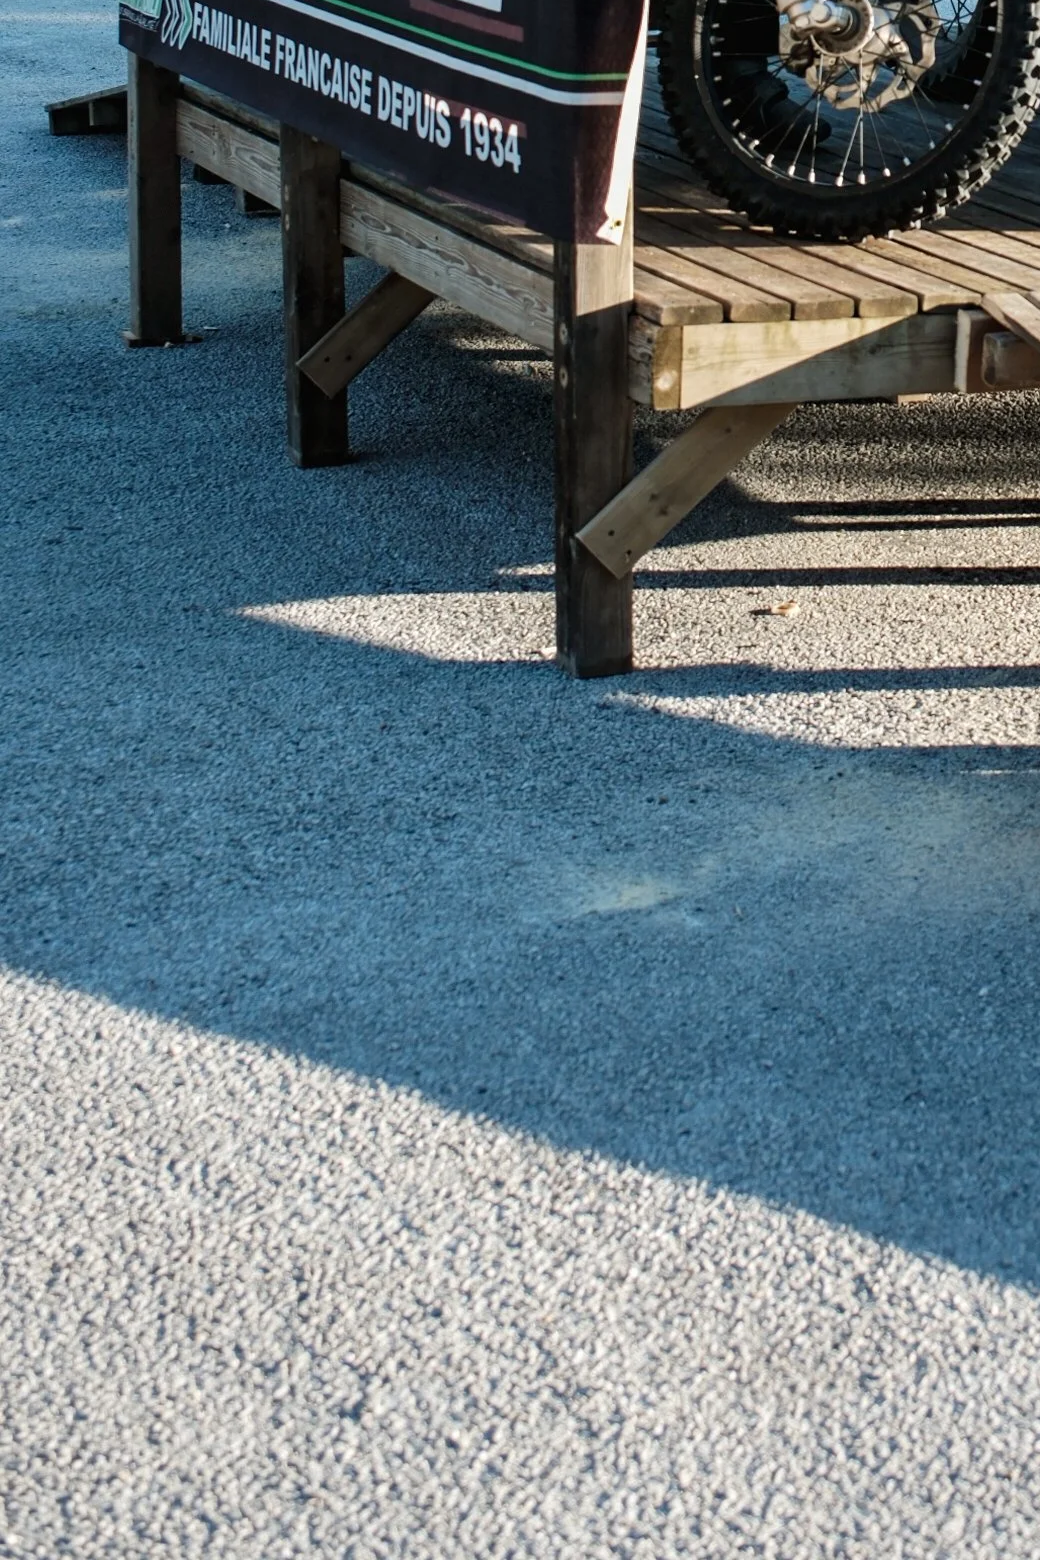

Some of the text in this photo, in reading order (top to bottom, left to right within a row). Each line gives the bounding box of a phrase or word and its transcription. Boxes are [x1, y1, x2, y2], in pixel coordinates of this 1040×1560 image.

[192, 1, 522, 175] FAMILIALE FRANCAISE DEPUIS 1934
